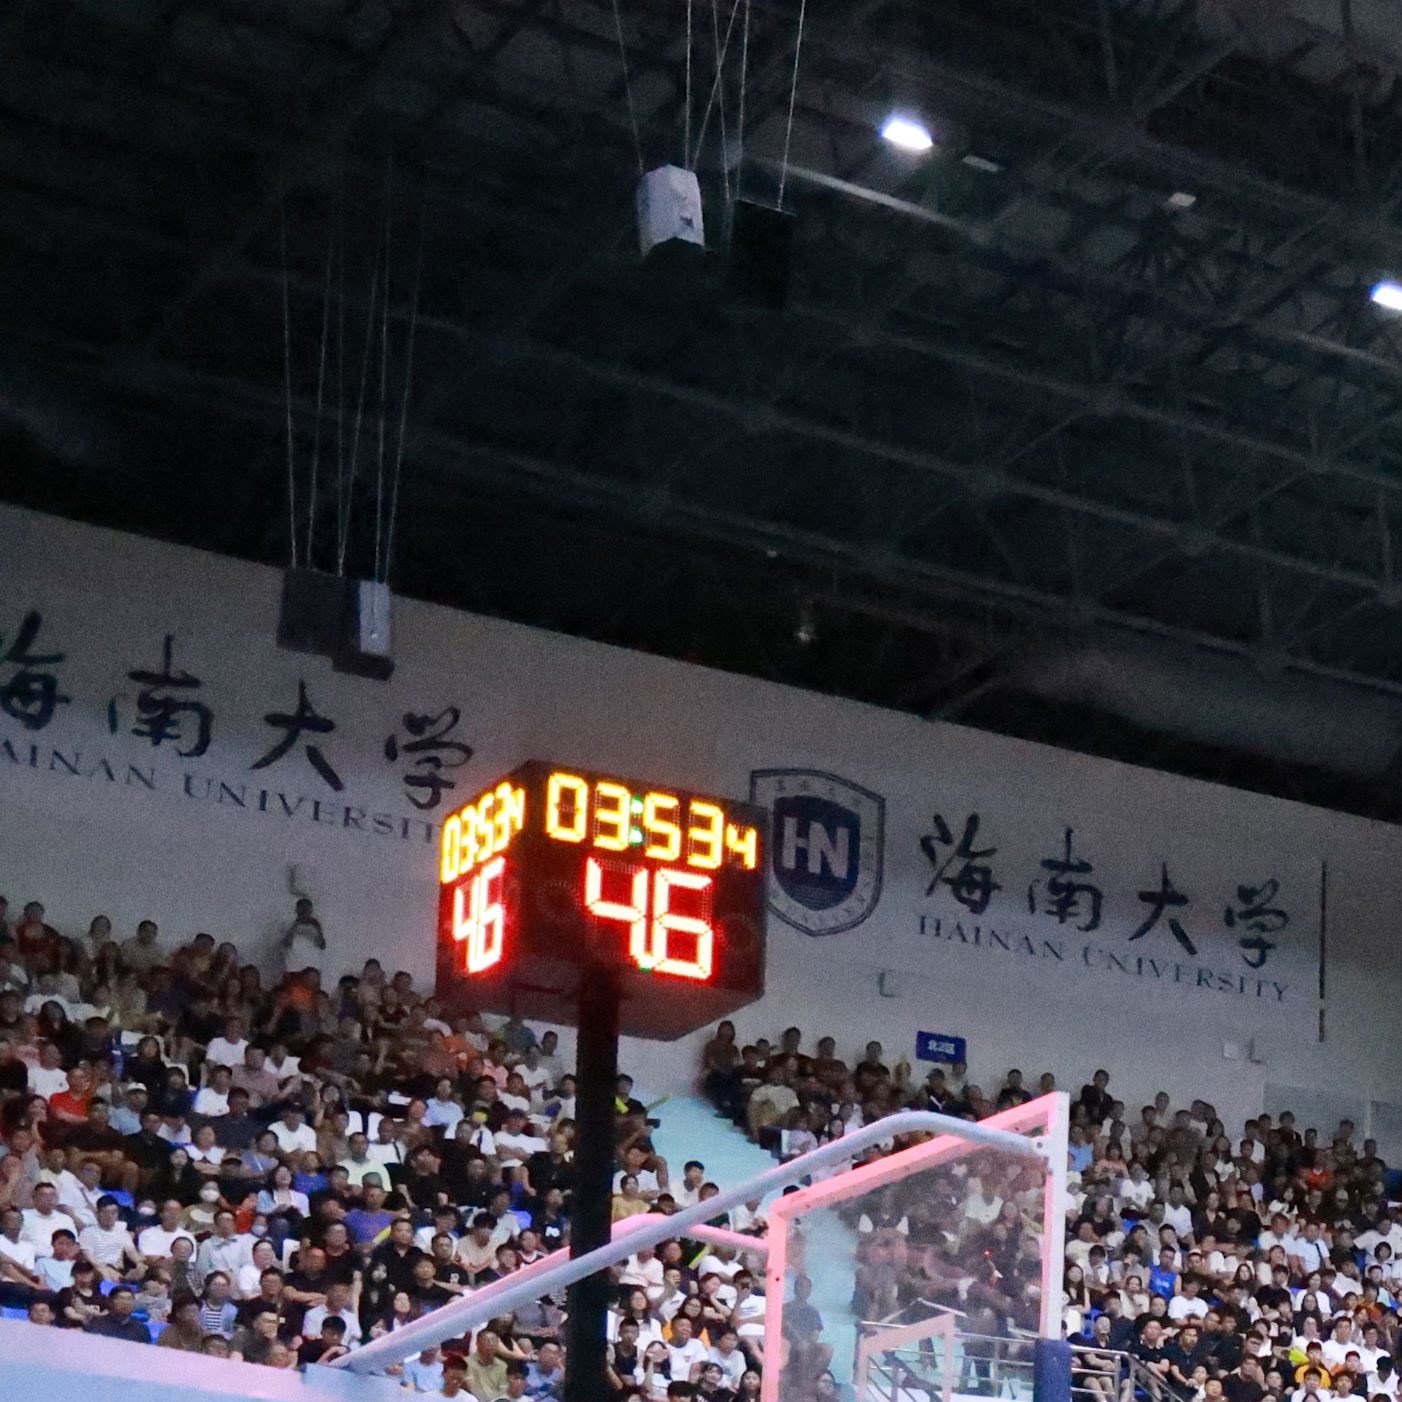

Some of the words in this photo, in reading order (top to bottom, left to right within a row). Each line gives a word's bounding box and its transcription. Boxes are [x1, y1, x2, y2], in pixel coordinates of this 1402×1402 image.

[183, 771, 441, 844] UNIVERSIT
[546, 771, 725, 869] 03:53
[585, 857, 715, 981] 46
[919, 812, 1290, 969] 海南大学
[918, 914, 1065, 961] HAINAN
[1080, 946, 1291, 1002] UNIVERSITY
